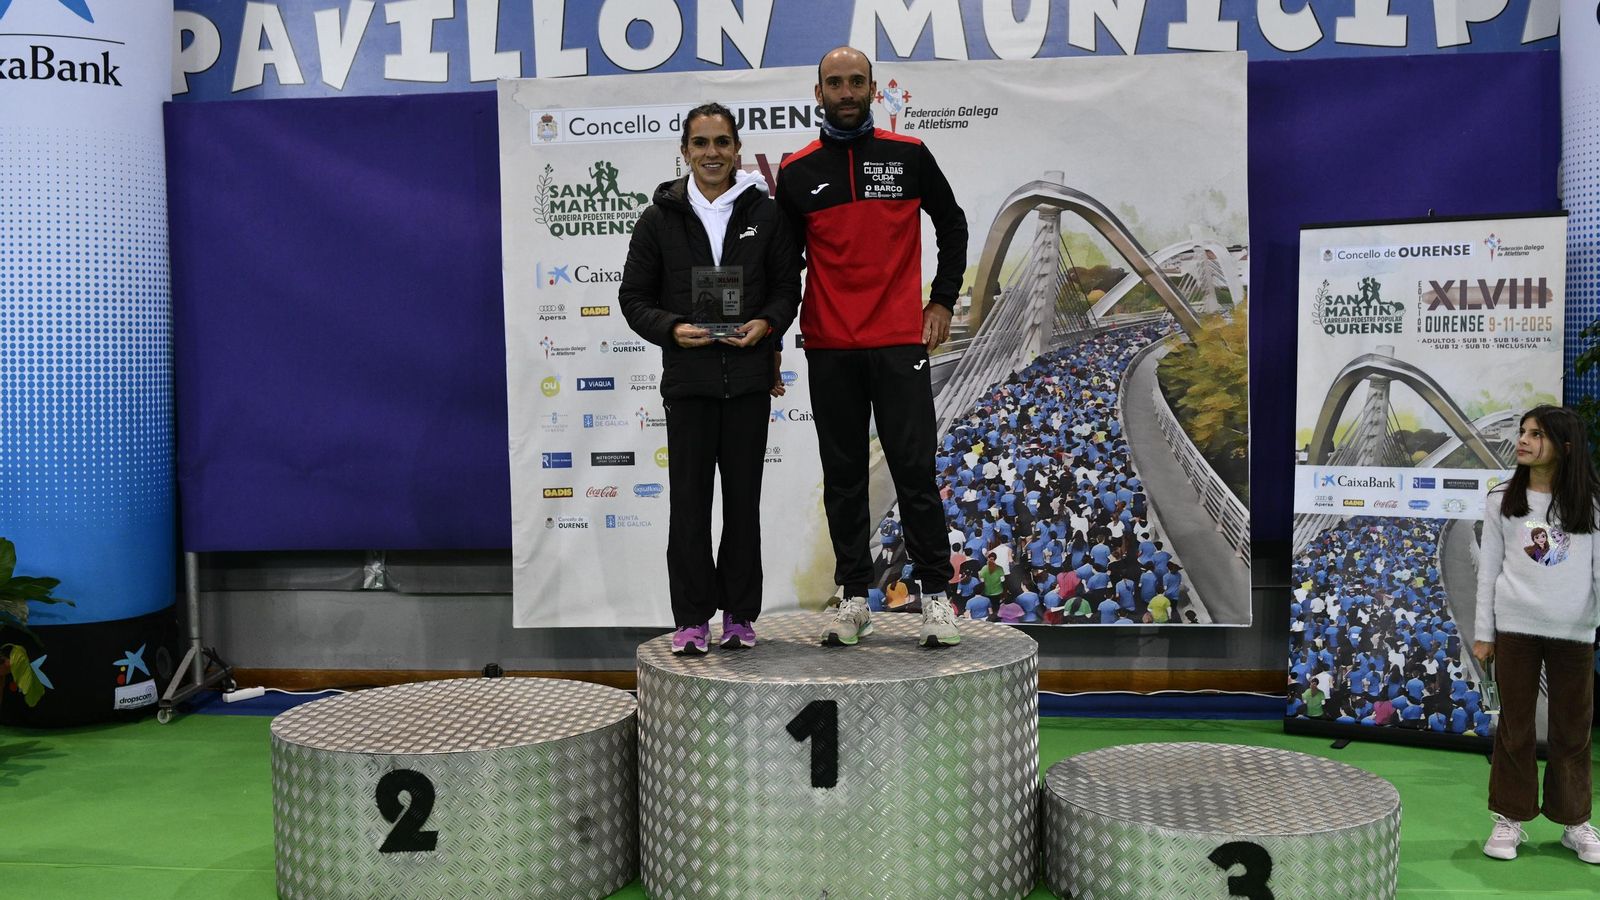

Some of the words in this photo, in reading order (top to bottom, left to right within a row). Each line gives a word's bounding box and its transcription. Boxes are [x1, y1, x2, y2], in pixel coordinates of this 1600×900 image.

[171, 0, 772, 95] PAVILLON
[848, 0, 1560, 61] MUNICIP
[904, 107, 955, 118] Federación
[958, 106, 998, 118] Galega
[569, 115, 660, 136] Concello
[669, 113, 680, 131] d
[904, 122, 915, 130] de
[918, 119, 969, 129] Atletismo
[864, 166, 883, 175] CLUB
[885, 166, 903, 175] ADAS
[549, 184, 591, 198] SAN
[550, 198, 633, 214] MARTIN
[550, 214, 581, 222] CARREIRA
[583, 213, 615, 221] PEDESTRE
[617, 212, 642, 220] POPULA
[550, 220, 635, 237] OURENS
[1338, 249, 1381, 260] Concello
[1384, 249, 1396, 258] de
[1398, 245, 1470, 258] OURENSE
[574, 265, 624, 283] Caixa
[1325, 295, 1358, 305] SAN
[1427, 277, 1547, 311] XLVIII
[582, 307, 609, 315] GADIS
[1325, 305, 1391, 317] MARTIN
[1324, 322, 1402, 334] OURENSE
[1425, 315, 1484, 332] OURENSE
[1489, 316, 1552, 332] 9-11-2025
[788, 409, 815, 421] Caix
[1338, 475, 1396, 488] CaixaBank
[120, 693, 152, 704] dropscom
[786, 699, 838, 788] 1
[376, 769, 439, 853] 2
[1208, 841, 1275, 900] 3
